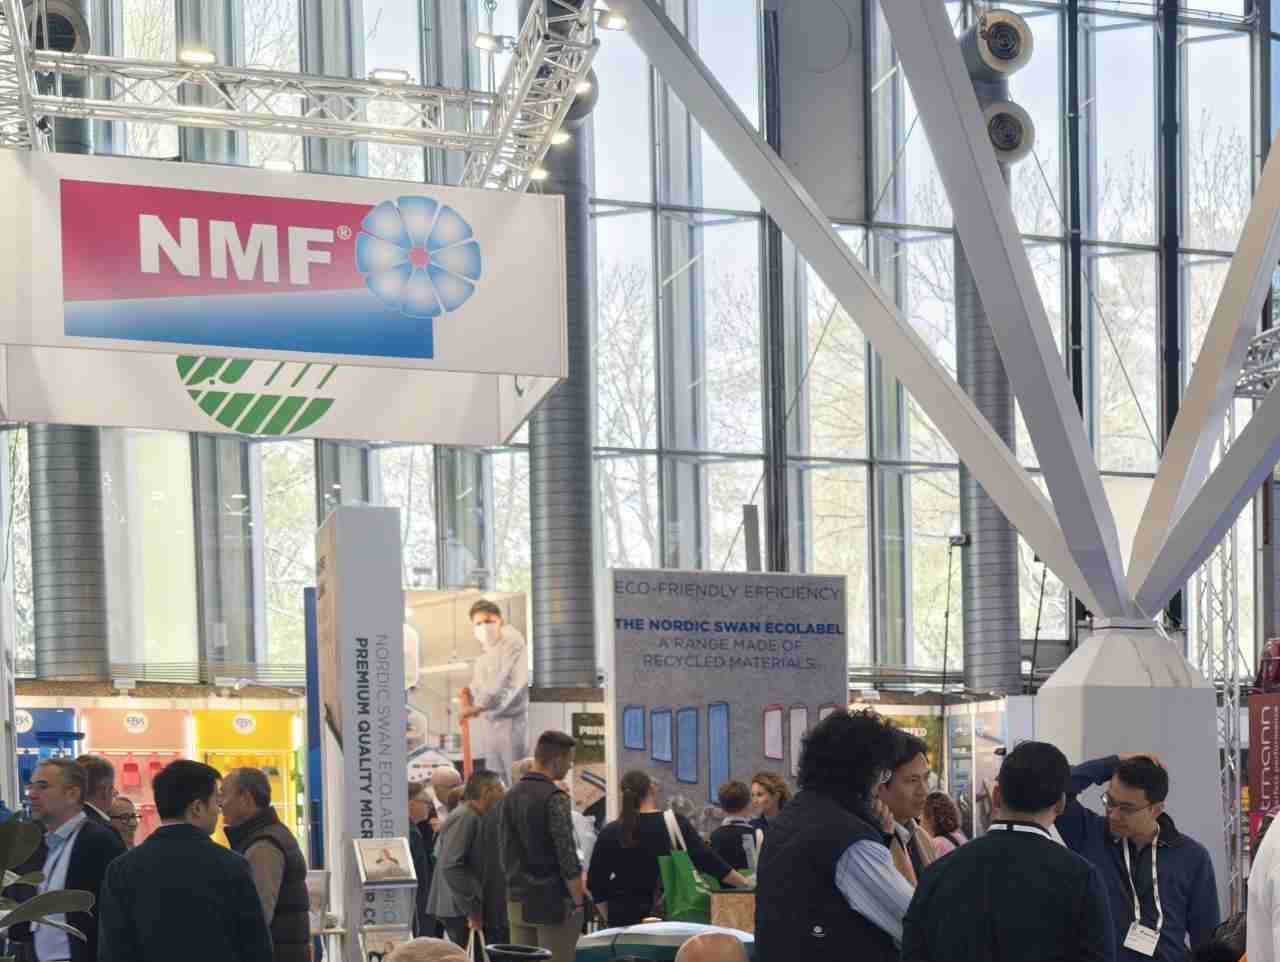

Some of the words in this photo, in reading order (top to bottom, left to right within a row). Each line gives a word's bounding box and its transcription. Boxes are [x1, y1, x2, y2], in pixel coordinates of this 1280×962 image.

[614, 580, 739, 599] ECO-FRIENDLY
[744, 584, 840, 601] EFFICIENCY
[614, 618, 644, 631] THE
[649, 618, 712, 633] NORDIC
[713, 621, 766, 634] SWAN
[767, 622, 845, 635] ECOLABEL
[658, 638, 669, 649] A
[674, 638, 729, 651] RANGE
[733, 639, 778, 651] MADE
[781, 639, 801, 652] OF
[355, 637, 371, 715] PREMIUM
[375, 634, 391, 701] NORDIC
[642, 653, 727, 669] RECYCLED
[729, 655, 817, 670] MATERIALS
[357, 720, 373, 794] QUALITY
[376, 705, 392, 757] SWAN
[1261, 705, 1271, 811] tmann
[359, 799, 374, 839] MICR
[378, 760, 394, 839] ECOLABE
